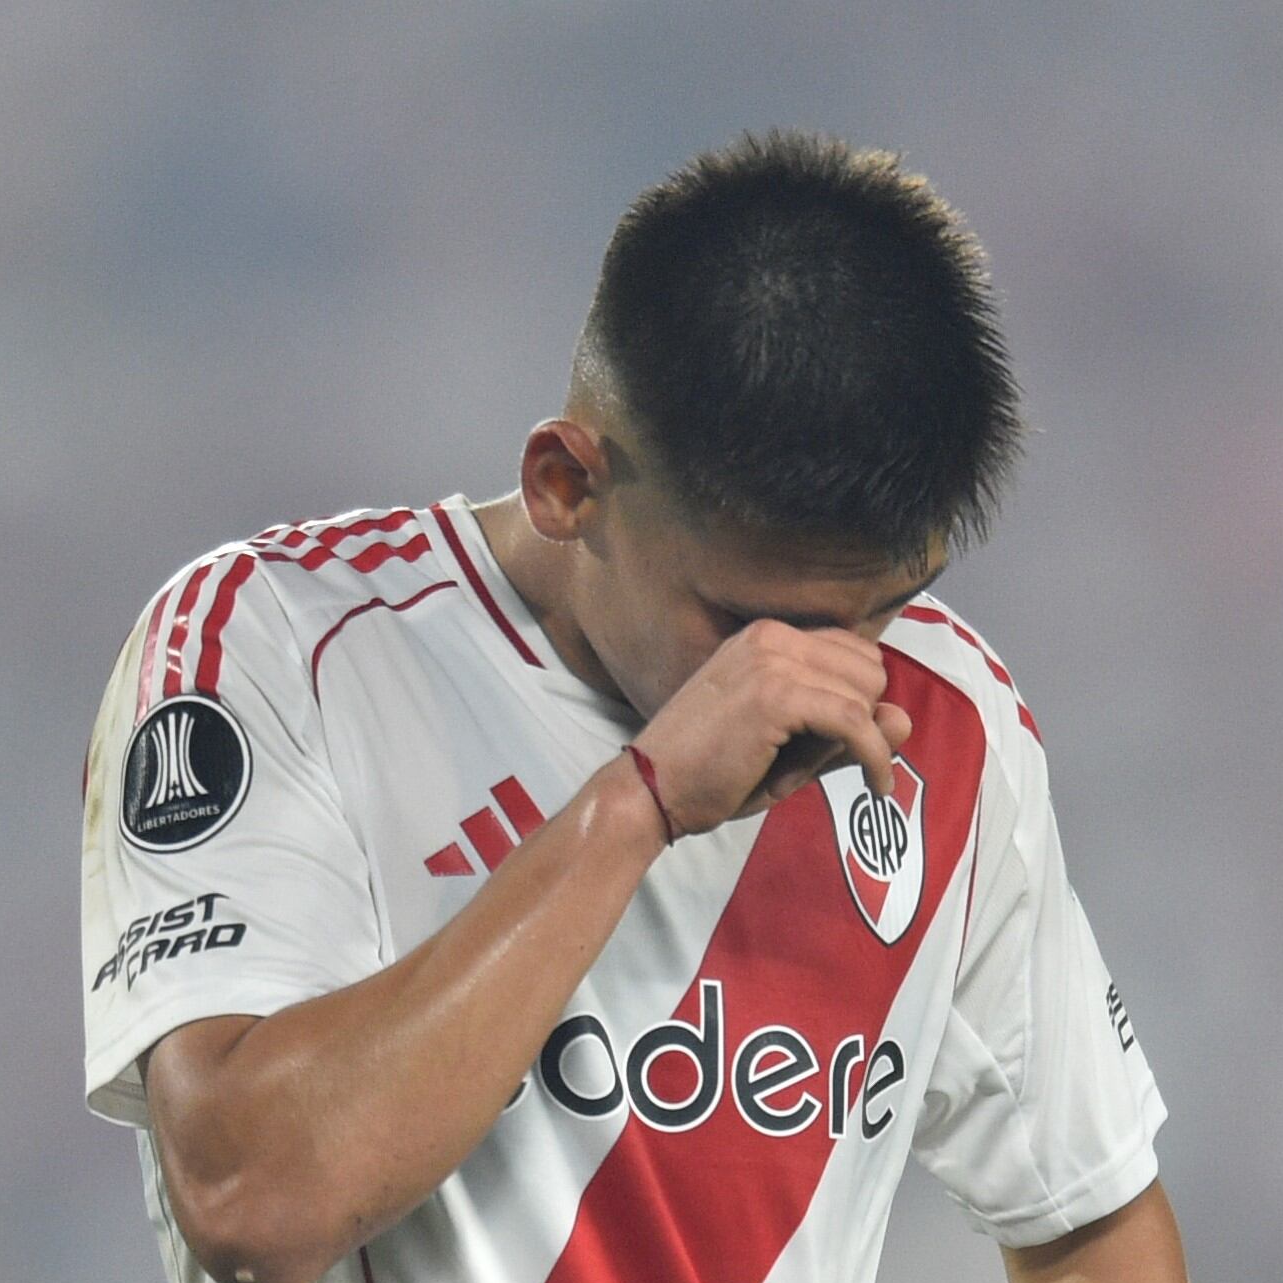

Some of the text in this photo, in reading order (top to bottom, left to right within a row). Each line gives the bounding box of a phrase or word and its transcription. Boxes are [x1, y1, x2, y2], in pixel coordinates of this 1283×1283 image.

[137, 804, 221, 832] LIBERTADORES
[126, 922, 247, 992] CARD
[502, 979, 906, 1141] odere
